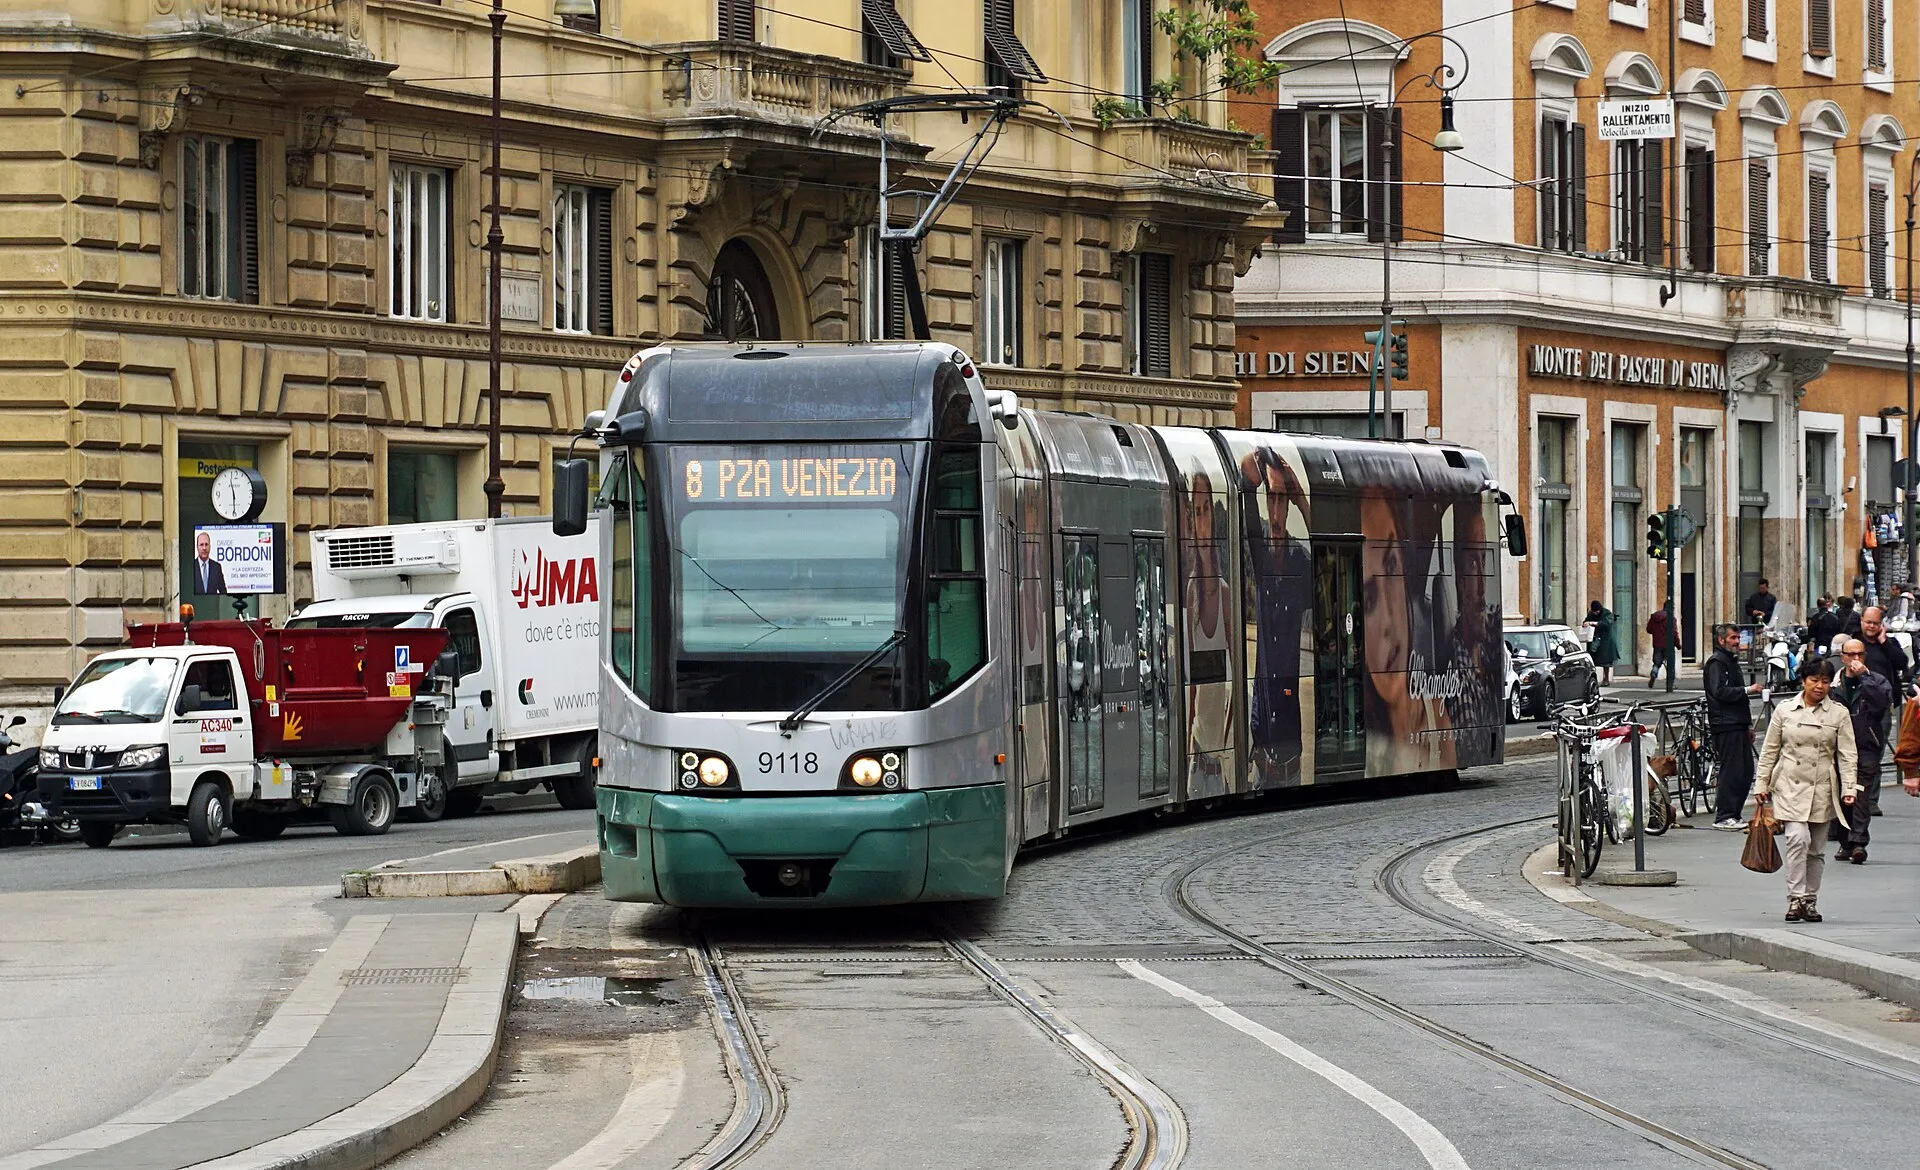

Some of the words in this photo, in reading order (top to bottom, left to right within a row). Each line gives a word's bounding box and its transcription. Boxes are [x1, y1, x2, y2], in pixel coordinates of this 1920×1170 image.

[1621, 104, 1650, 112] INIZIO
[1602, 113, 1671, 126] RALLENTAMENTO
[508, 283, 521, 297] VIA
[1267, 351, 1297, 375] DI
[1533, 344, 1583, 377] MONTE
[1589, 350, 1614, 380] DEI
[1619, 354, 1666, 385] PASCHI
[1670, 359, 1685, 386] DI
[1688, 361, 1727, 391] SIENA
[686, 460, 703, 498] 8
[719, 459, 771, 497] PZA
[781, 457, 897, 497] VENEZIA
[216, 546, 272, 562] BORDONI
[341, 614, 370, 622] RACCHI
[525, 620, 553, 643] dove
[556, 617, 573, 640] c'è
[1408, 648, 1464, 718] Wrangler
[200, 719, 233, 733] AC340
[758, 751, 819, 775] 9118
